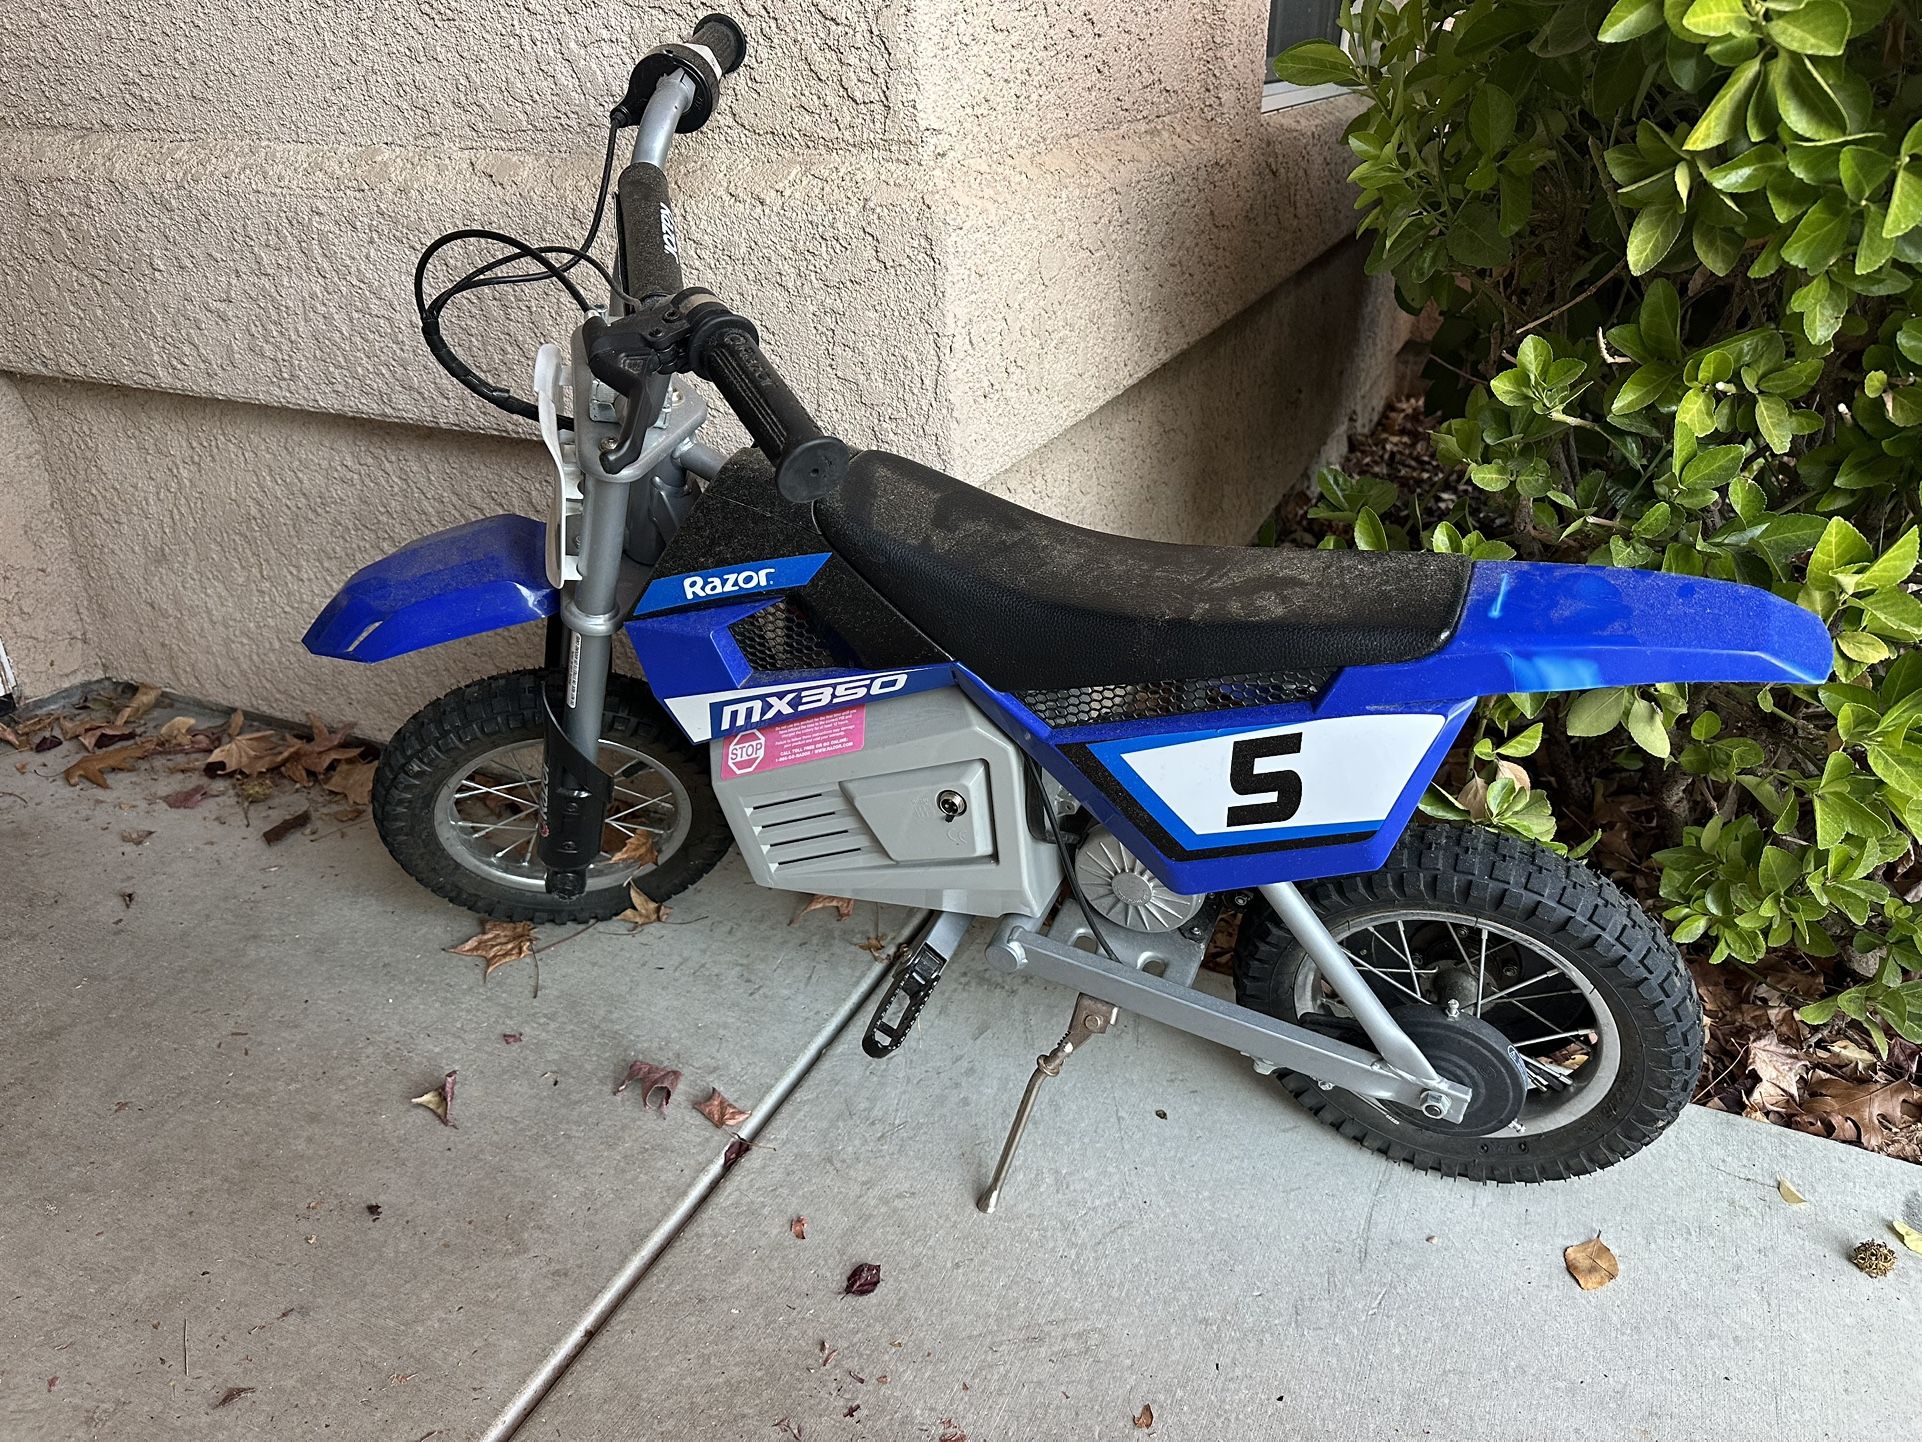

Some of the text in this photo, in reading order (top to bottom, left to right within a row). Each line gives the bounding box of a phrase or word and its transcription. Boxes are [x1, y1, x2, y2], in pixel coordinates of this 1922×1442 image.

[660, 201, 678, 264] Razor
[683, 568, 776, 600] Razor
[720, 674, 908, 730] MX350
[730, 742, 762, 761] STOP
[1226, 732, 1302, 827] 5
